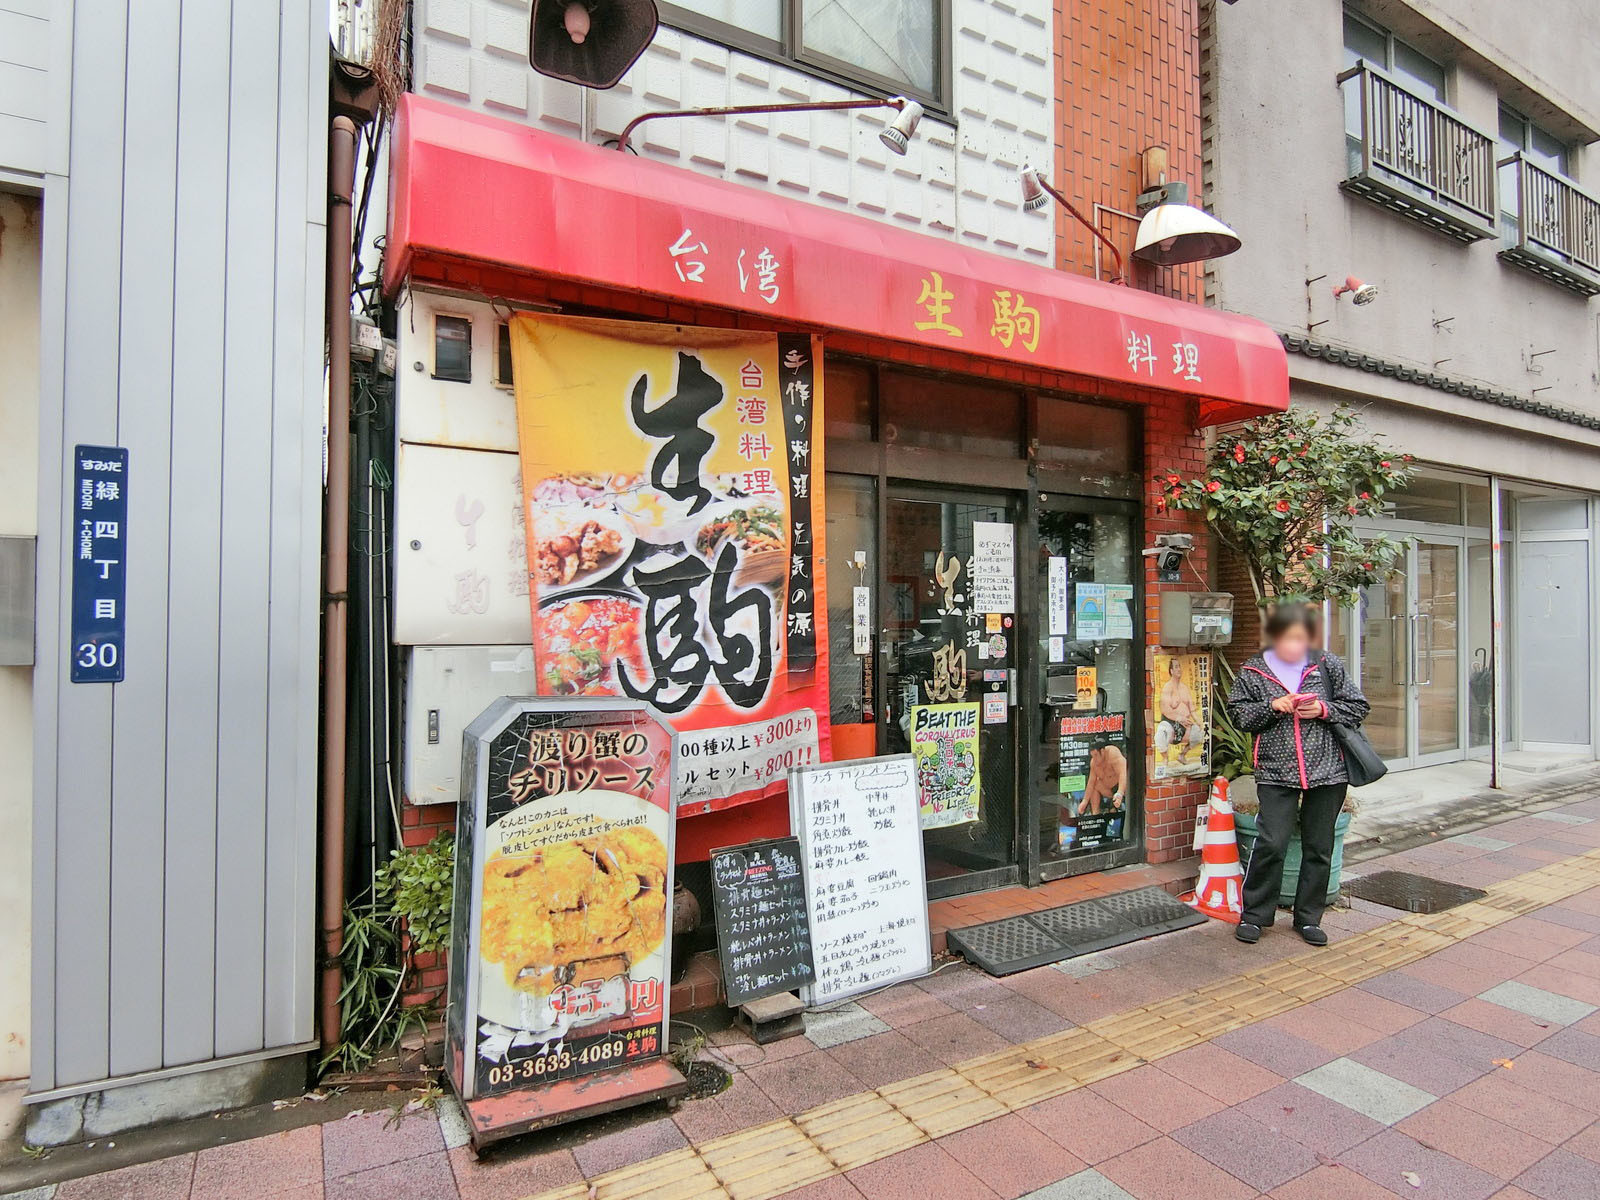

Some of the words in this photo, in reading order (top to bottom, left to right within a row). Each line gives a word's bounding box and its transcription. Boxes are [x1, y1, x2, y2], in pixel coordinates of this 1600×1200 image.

[668, 227, 781, 305] 台湾
[914, 271, 1041, 353] 生駒
[1126, 333, 1202, 384] 料理
[737, 359, 776, 496] 台湾料理
[81, 459, 122, 472] すみだ
[81, 479, 94, 510] MIDORI
[80, 519, 93, 560] 4-CHOME
[94, 480, 120, 619] 緑四丁目
[856, 592, 867, 648] 営業中
[79, 643, 118, 668] 30
[915, 708, 952, 732] BEAT
[952, 709, 976, 728] THE
[915, 727, 976, 743] CORONAVIRUS
[531, 730, 649, 764] 渡り蟹の
[510, 766, 656, 800] チリソース
[676, 760, 750, 785] ルセット
[626, 1026, 657, 1041] 台湾料理
[626, 1036, 657, 1057] 生駒
[489, 1040, 623, 1086] 03-3633-4089
